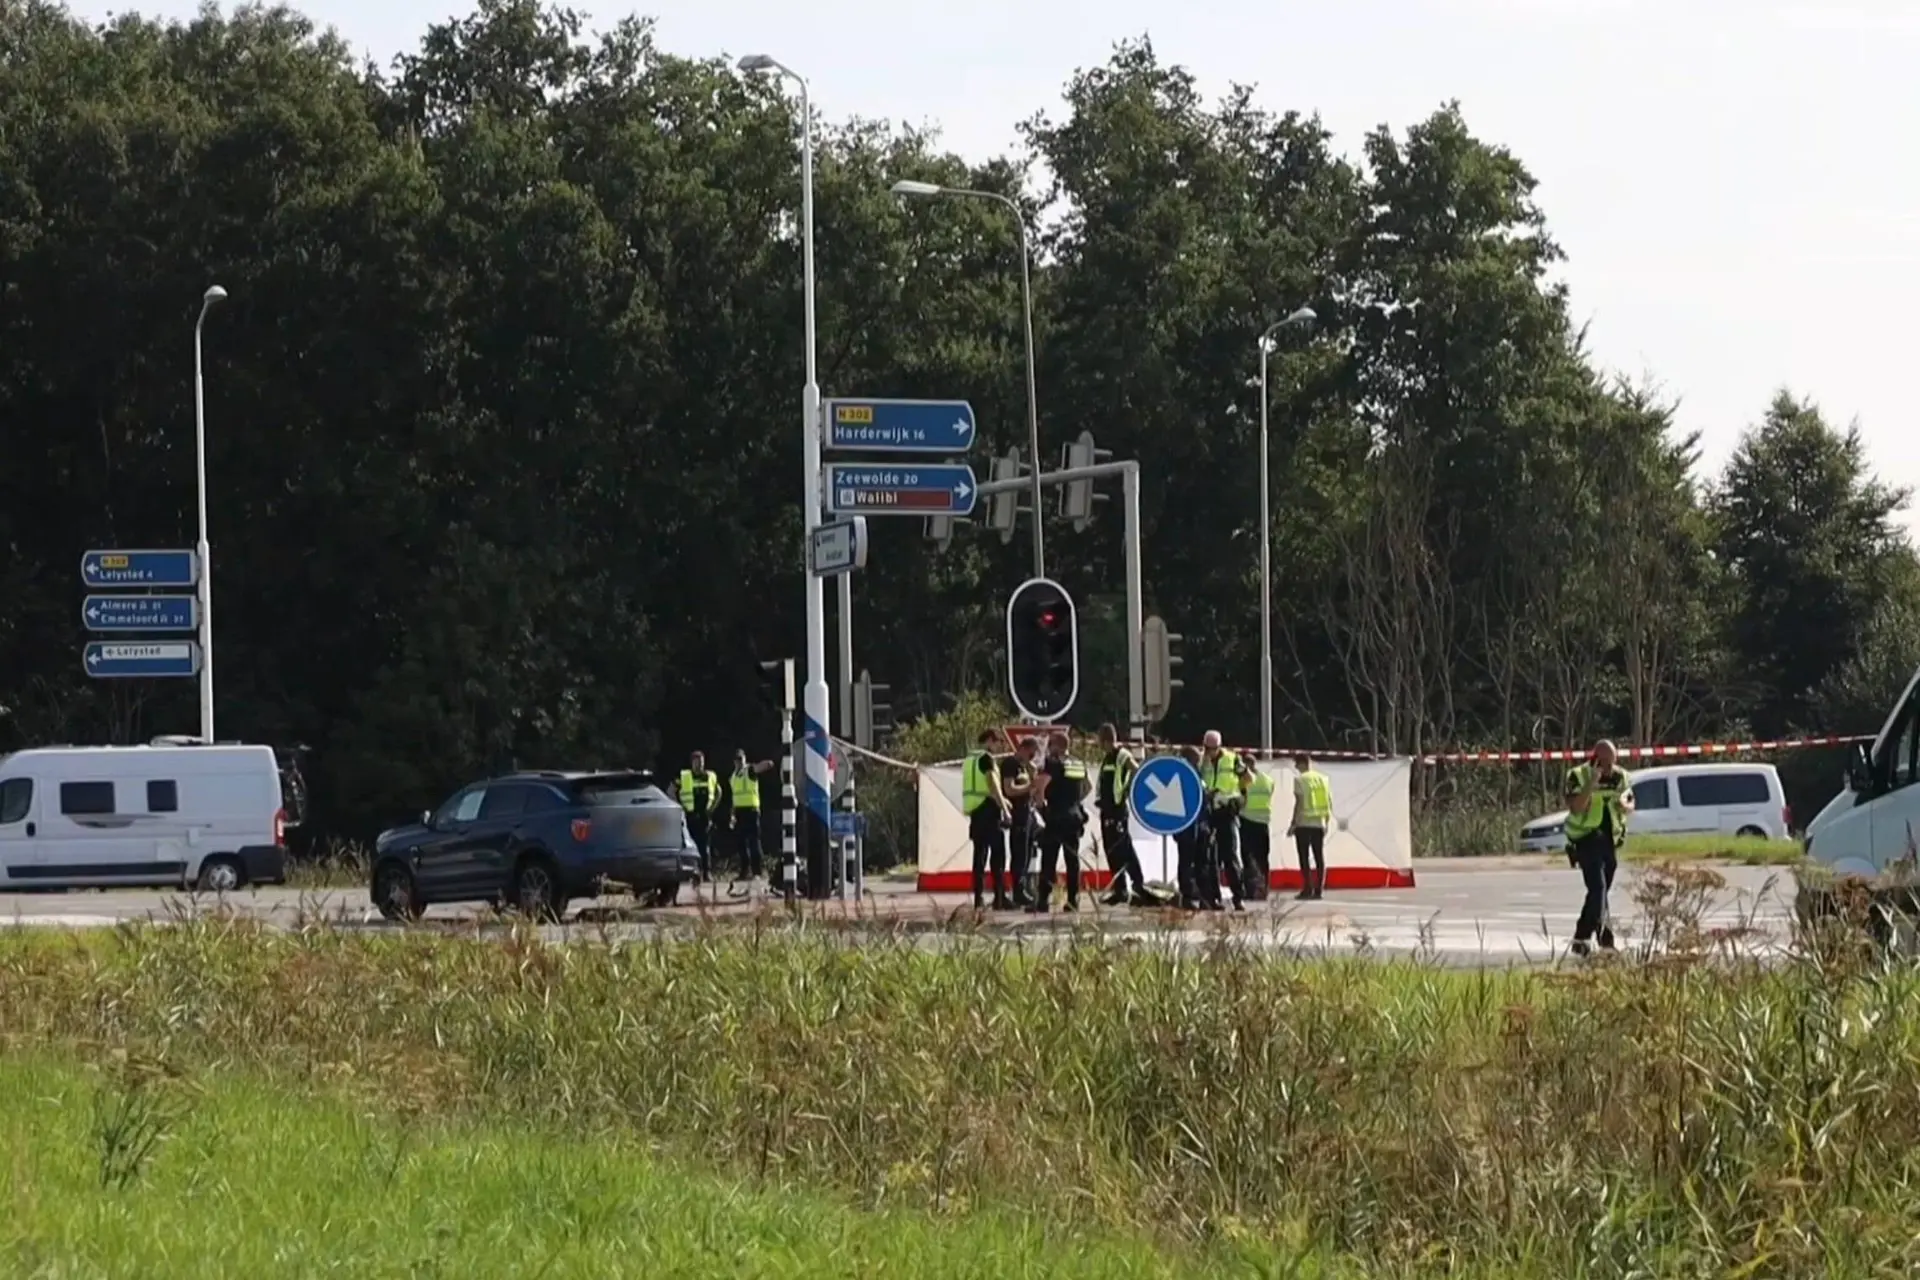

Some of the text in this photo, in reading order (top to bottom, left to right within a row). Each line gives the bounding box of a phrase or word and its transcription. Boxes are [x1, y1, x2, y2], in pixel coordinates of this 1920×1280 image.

[835, 426, 925, 443] Harderwijk 16
[836, 471, 918, 485] Zeewolde 20
[856, 491, 898, 504] Walibi
[100, 570, 144, 580] Lelystad
[101, 601, 137, 610] Almere
[101, 614, 158, 624] Emmeloord
[117, 647, 160, 656] Lelystad
